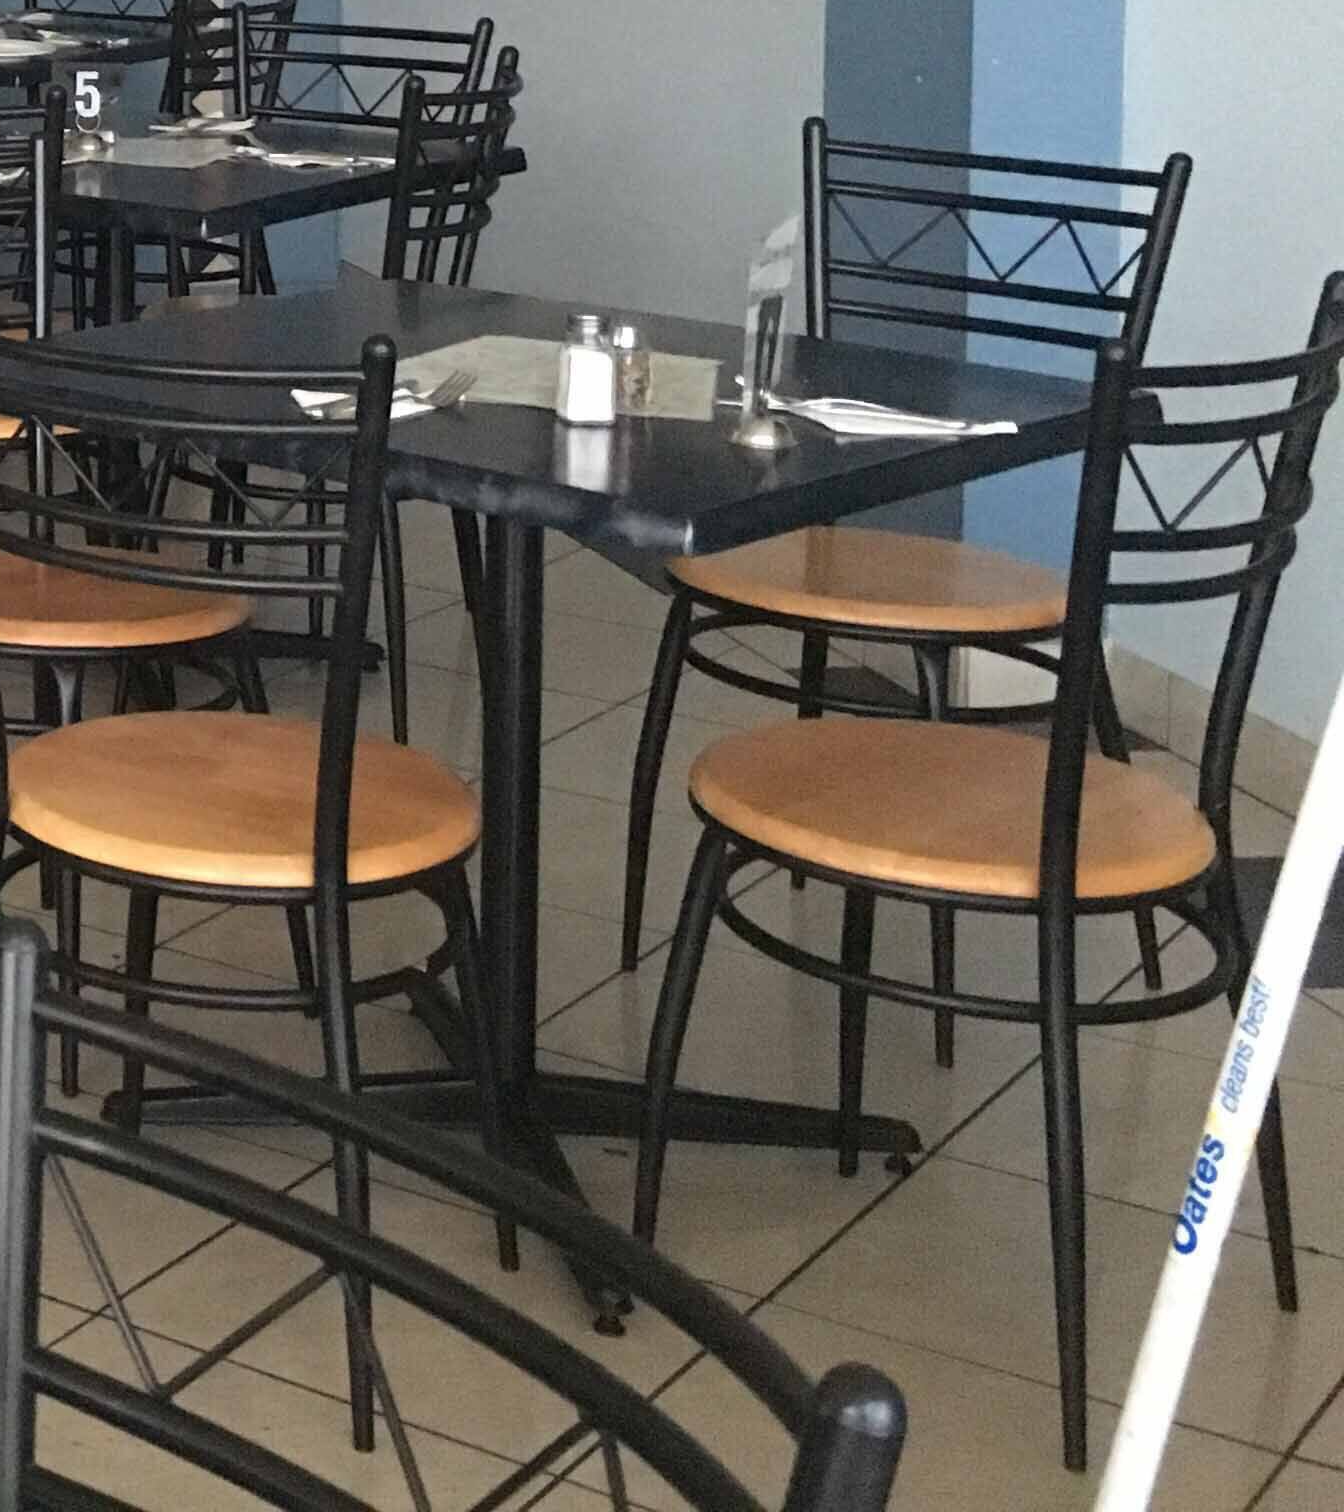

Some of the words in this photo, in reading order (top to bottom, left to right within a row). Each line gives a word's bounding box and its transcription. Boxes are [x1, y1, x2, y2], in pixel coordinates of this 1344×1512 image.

[75, 71, 100, 117] 5
[1172, 1133, 1224, 1255] Oates
[1221, 1040, 1254, 1113] cleans
